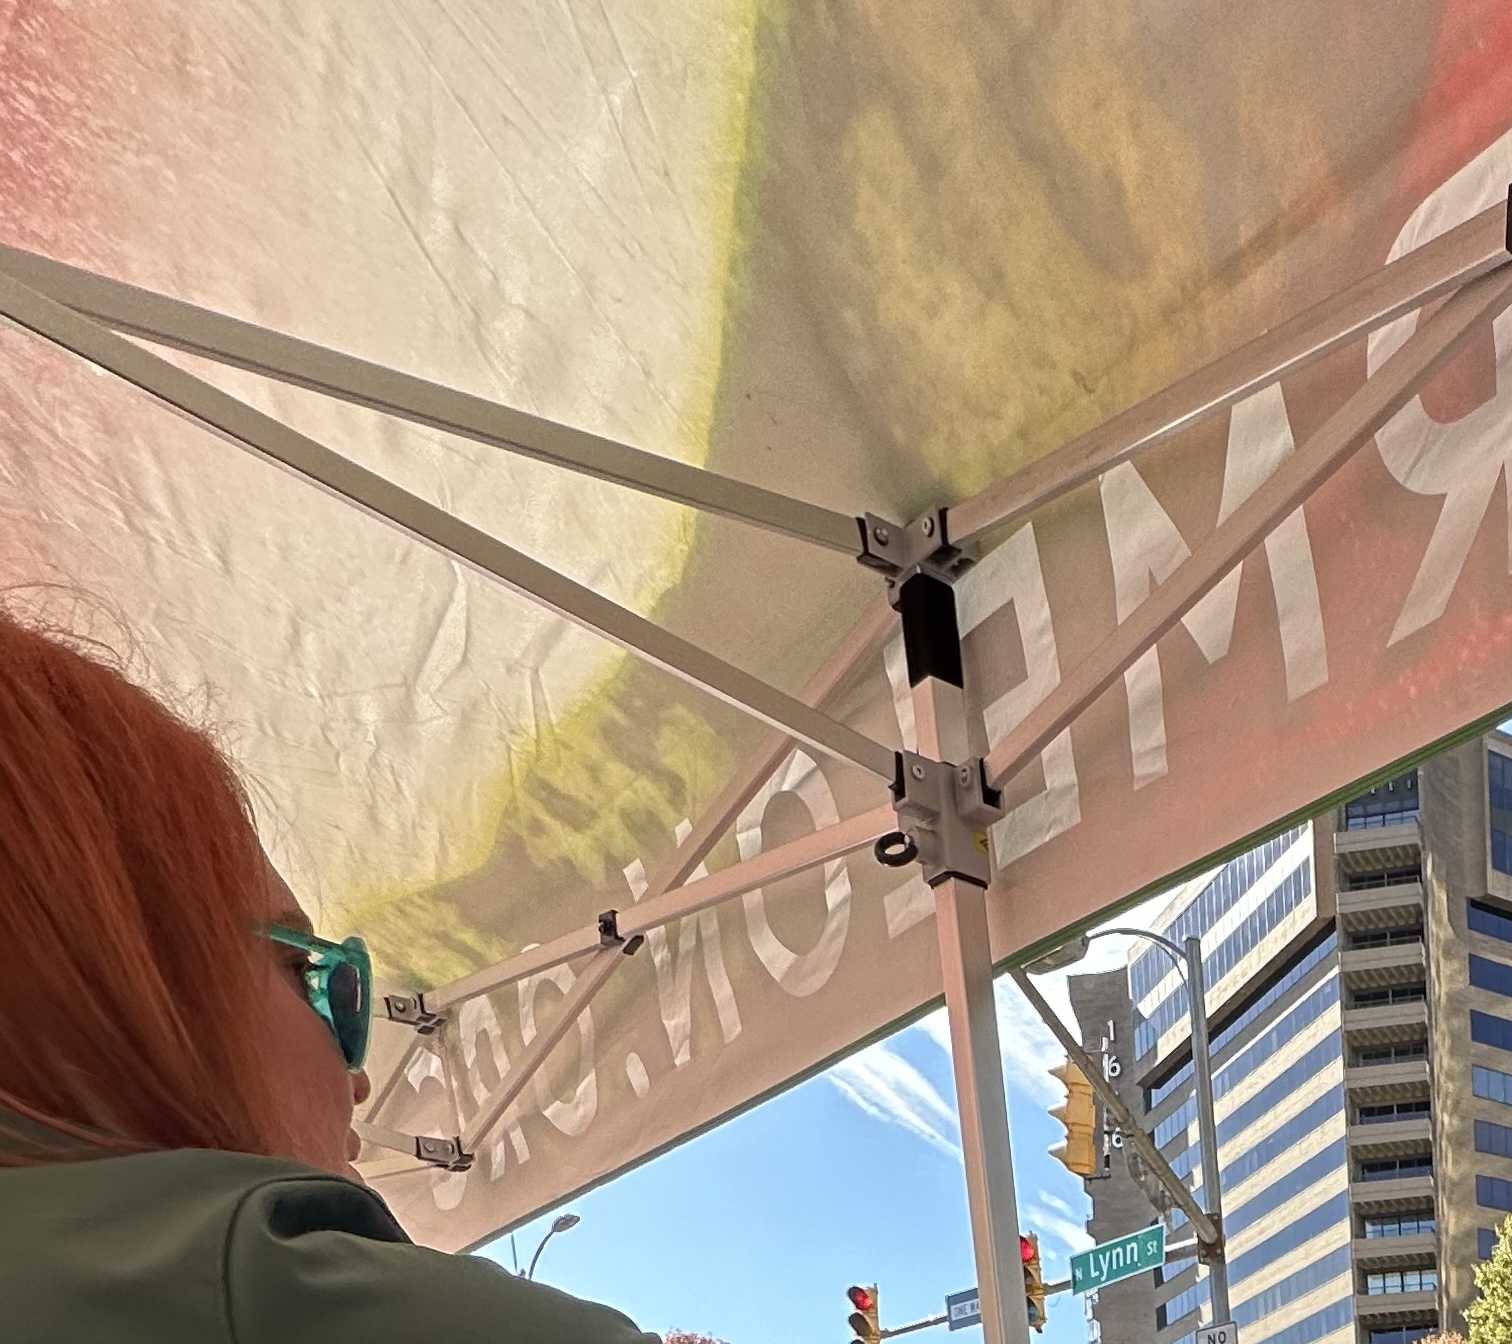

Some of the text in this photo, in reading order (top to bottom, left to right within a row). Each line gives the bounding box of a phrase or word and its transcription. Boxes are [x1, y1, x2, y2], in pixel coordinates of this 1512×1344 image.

[1075, 1240, 1158, 1282] N Lynn St
